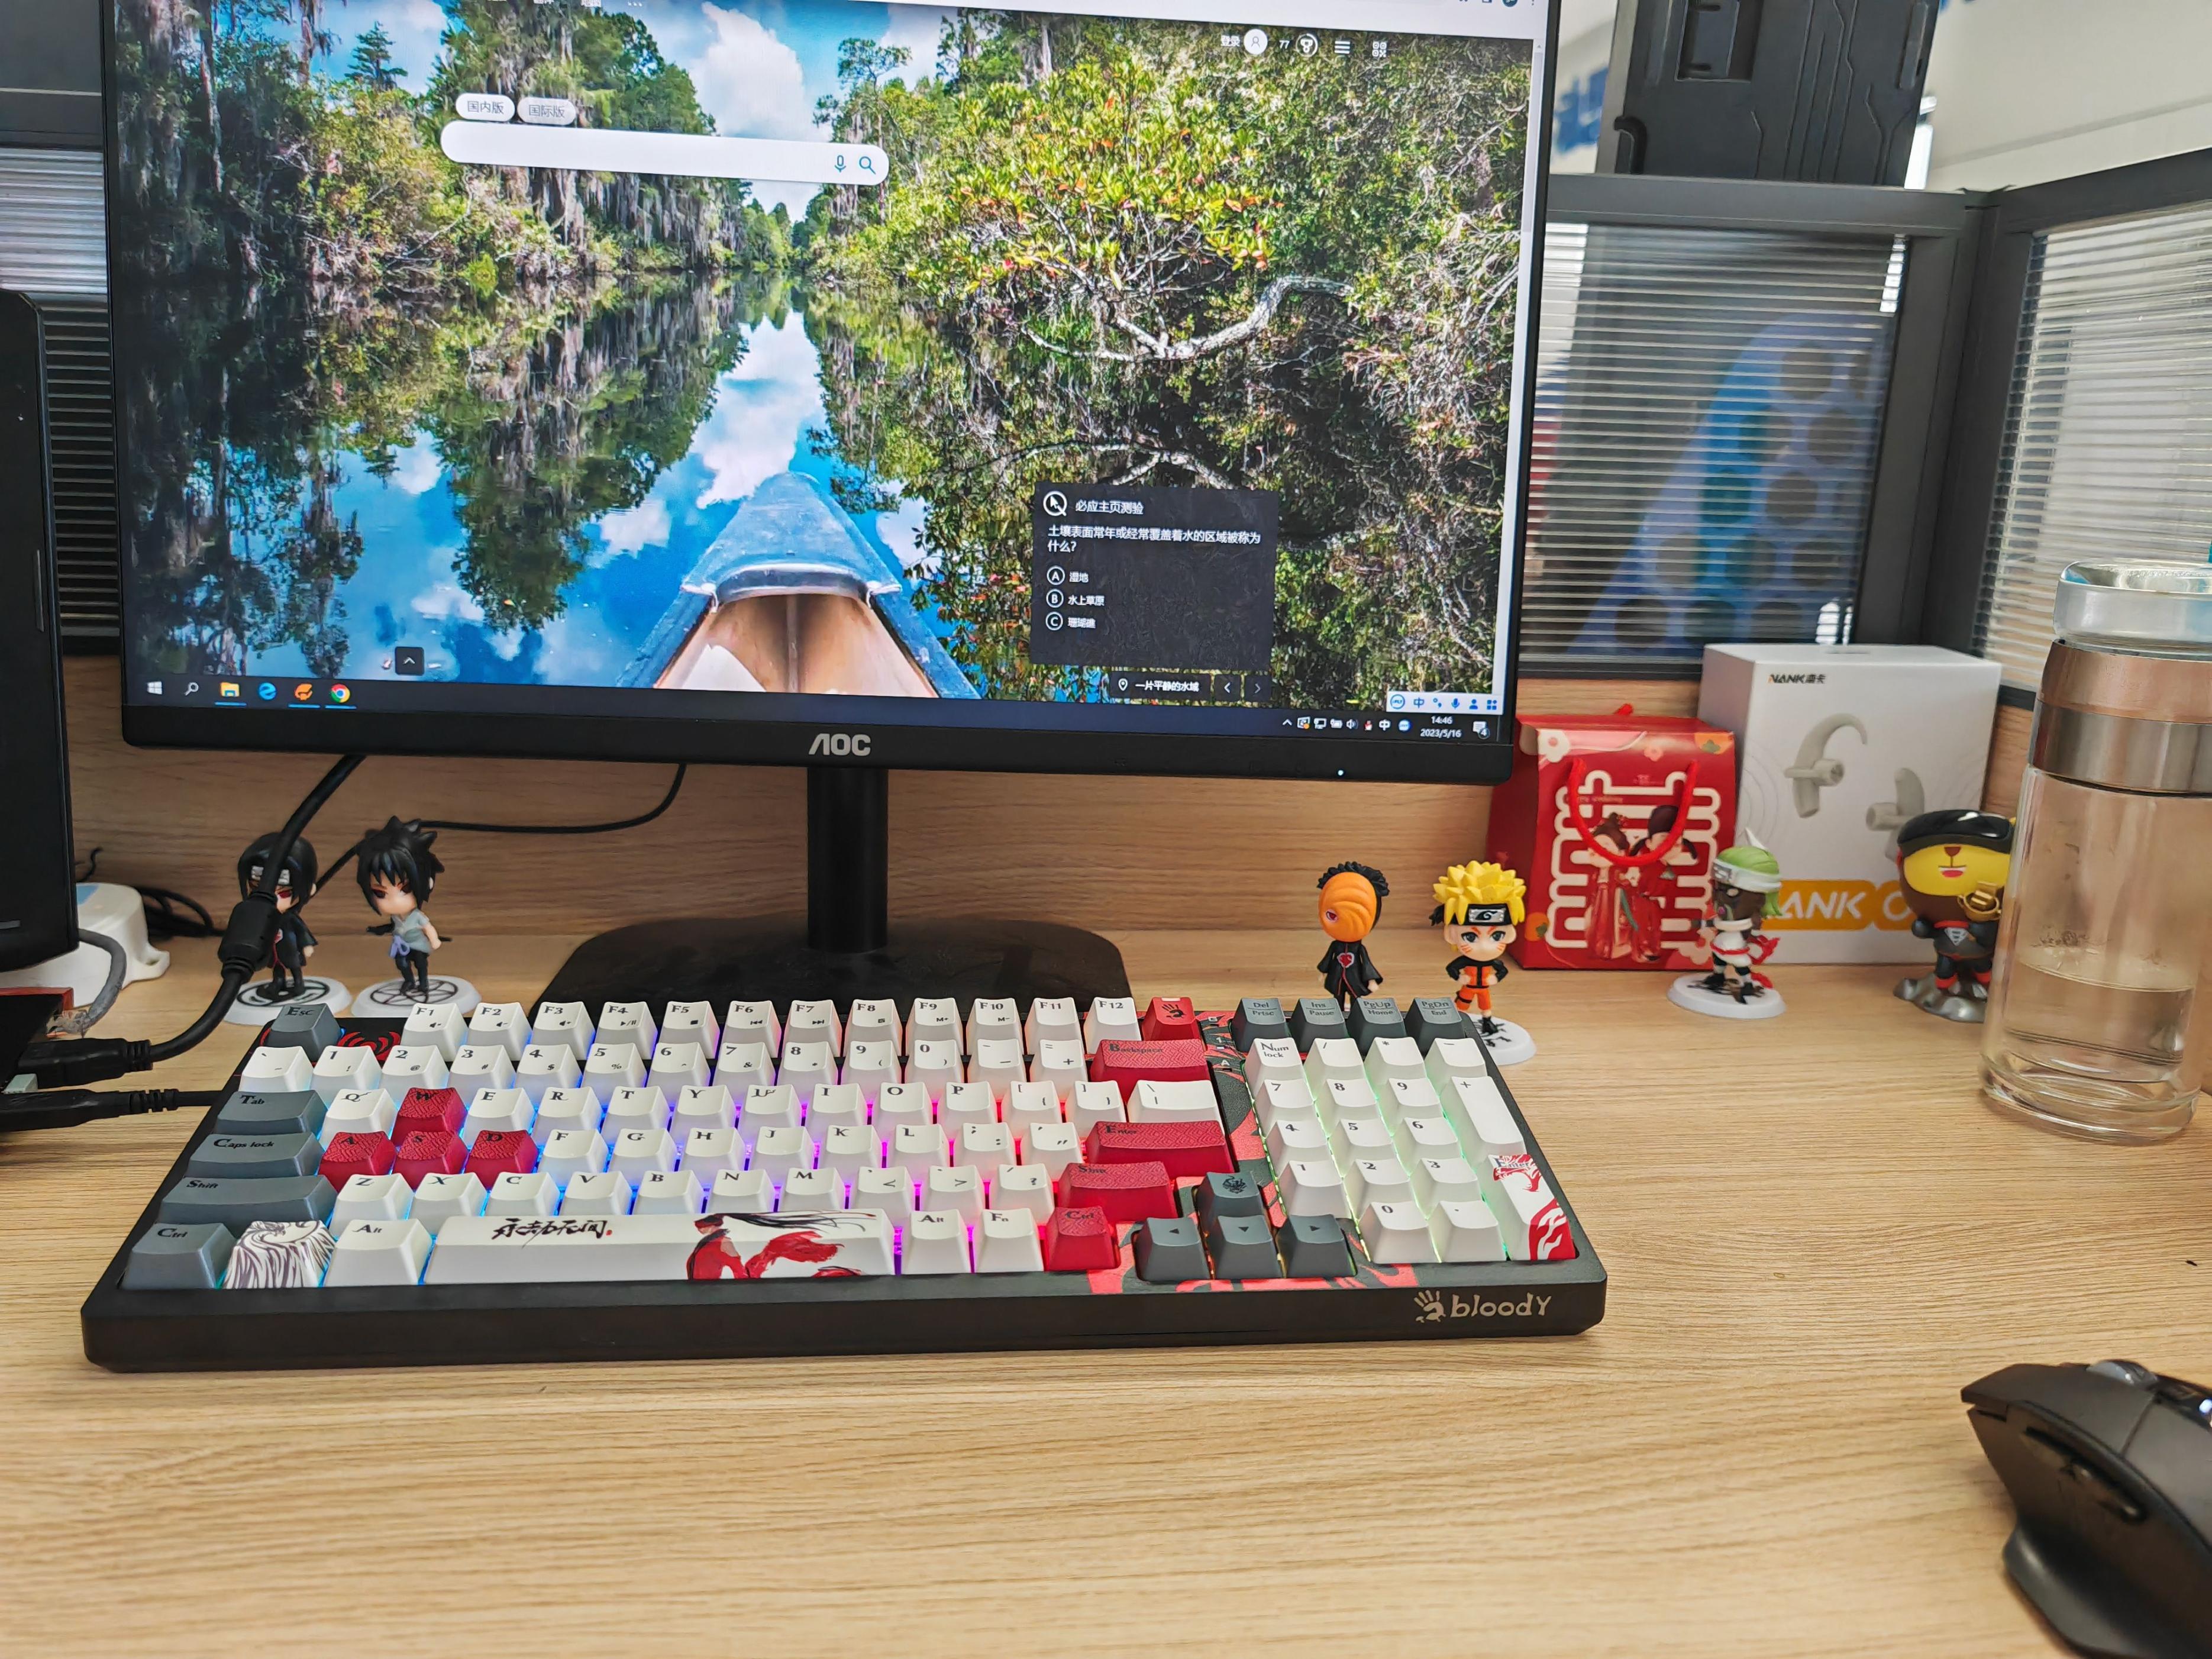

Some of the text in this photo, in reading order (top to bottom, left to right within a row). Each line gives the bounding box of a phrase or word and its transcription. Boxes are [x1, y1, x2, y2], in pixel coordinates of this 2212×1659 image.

[467, 101, 504, 115] 国内版
[528, 105, 566, 118] 国际版
[1076, 500, 1144, 515] 必应主页测验
[1048, 525, 1261, 544] 土壤表面常年或经常覆盖着水的区域被称为
[1068, 595, 1105, 606] 水上草原
[1413, 697, 1425, 709] 中
[1430, 715, 1453, 725] 14:46
[1420, 728, 1462, 738] 2023/5/16
[808, 733, 871, 756] AOC
[1775, 890, 1867, 920] ANK
[735, 1004, 754, 1014] F6
[796, 1003, 815, 1013] F7
[857, 1003, 876, 1012] F8
[919, 1001, 938, 1010] F9
[979, 1001, 1004, 1010] F10
[1039, 1001, 1061, 1010] F11
[1099, 1000, 1123, 1009] F12
[285, 1006, 315, 1016] Esc
[416, 1007, 434, 1016] F1
[481, 1007, 502, 1016] F2
[544, 1005, 563, 1014] F3
[608, 1005, 628, 1014] F4
[671, 1005, 690, 1014] F5
[726, 1045, 737, 1055] 7
[790, 1046, 801, 1056] 8
[855, 1045, 867, 1054] 9
[1260, 1042, 1289, 1051] Num
[330, 1050, 338, 1060] 1
[395, 1050, 408, 1059] 2
[461, 1049, 474, 1058] 3
[529, 1049, 543, 1058] 4
[594, 1048, 607, 1057] 5
[660, 1047, 671, 1056] 6
[1263, 1050, 1286, 1058] lock
[952, 1085, 964, 1095] P
[1271, 1082, 1281, 1092] 7
[1334, 1083, 1345, 1091] 8
[1397, 1082, 1408, 1090] 9
[481, 1091, 496, 1101] E
[550, 1091, 564, 1100] R
[621, 1090, 635, 1099] T
[690, 1089, 703, 1099] Y
[823, 1087, 829, 1096] I
[240, 1095, 265, 1105] Tab
[343, 1092, 371, 1102] Q
[1285, 1124, 1298, 1132] 4
[1348, 1122, 1358, 1131] 5
[1412, 1121, 1423, 1129] 6
[555, 1131, 569, 1141] F
[627, 1132, 645, 1141] G
[696, 1131, 713, 1140] H
[764, 1129, 777, 1140] J
[835, 1127, 848, 1137] K
[903, 1128, 915, 1137] L
[213, 1138, 247, 1150] Caps
[341, 1136, 356, 1145] A
[1363, 1162, 1377, 1170] 2
[506, 1176, 522, 1184] C
[580, 1174, 596, 1183] V
[650, 1173, 664, 1182] B
[724, 1172, 740, 1181] N
[795, 1171, 813, 1180] M
[186, 1179, 219, 1189] Shift
[356, 1177, 374, 1186] Z
[428, 1176, 454, 1186] X
[991, 1212, 1009, 1222] Fn
[157, 1228, 188, 1238] Ctrl
